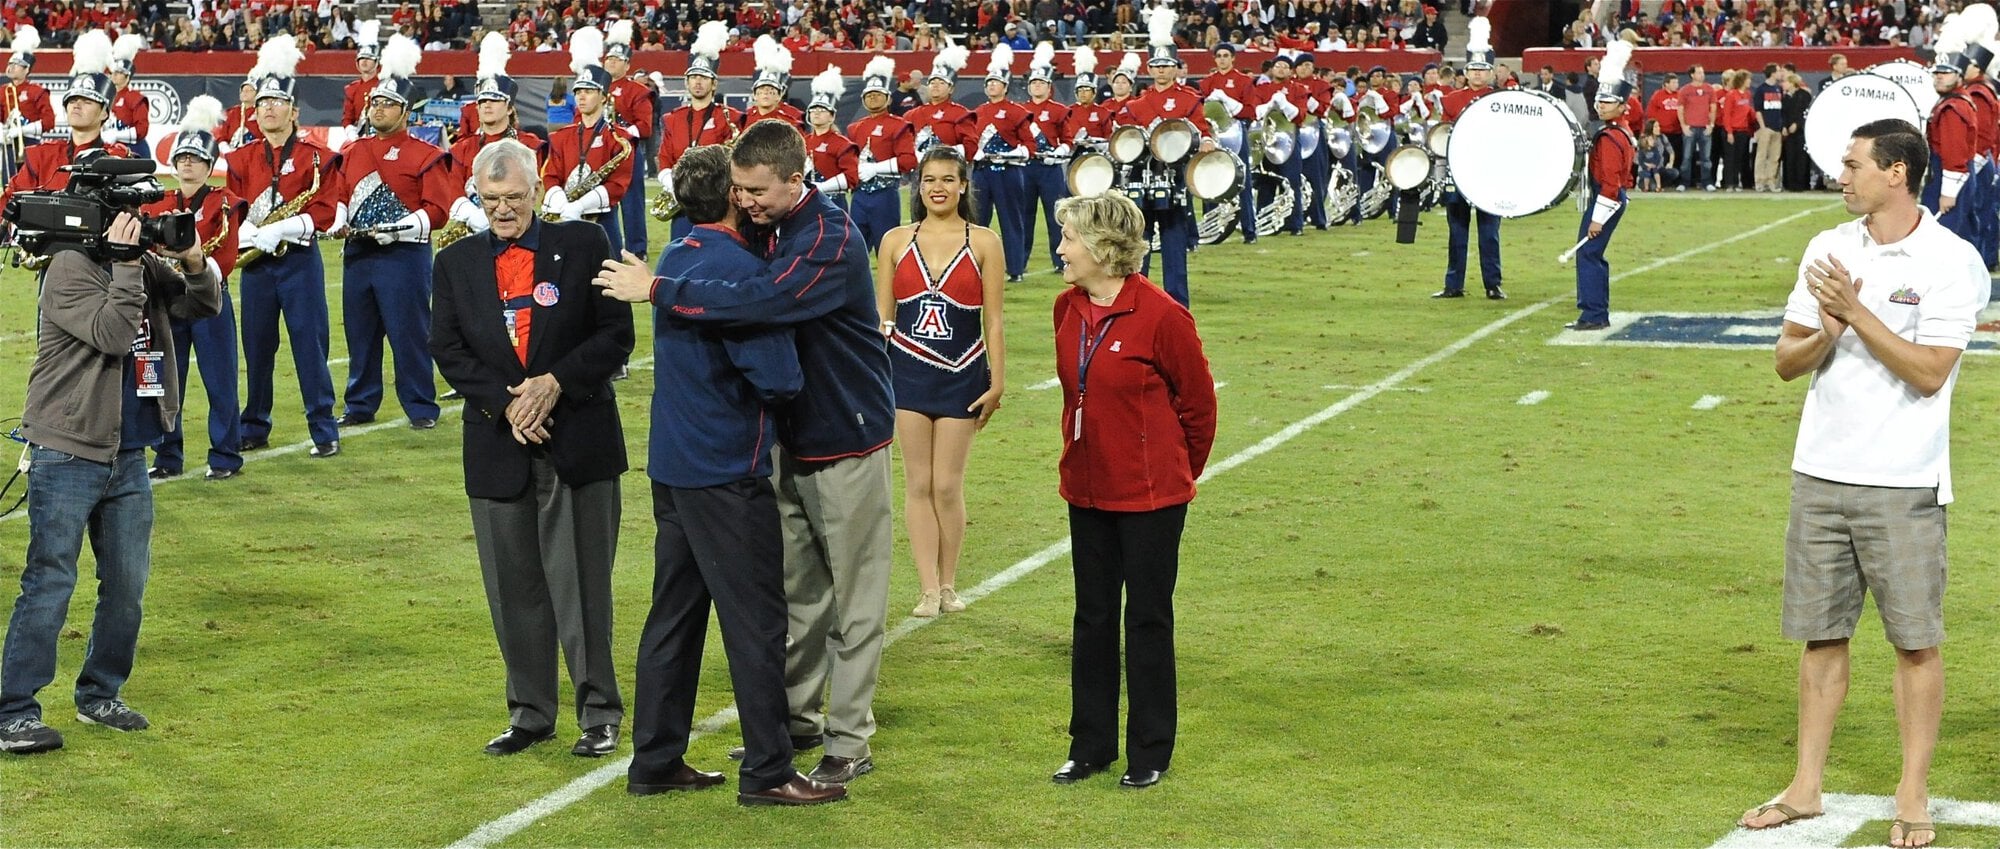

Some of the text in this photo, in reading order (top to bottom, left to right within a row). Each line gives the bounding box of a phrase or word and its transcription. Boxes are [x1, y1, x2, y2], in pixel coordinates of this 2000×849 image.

[1855, 88, 1895, 101] YAMAHA
[1503, 103, 1543, 117] YAMAHA
[912, 300, 953, 340] A
[142, 362, 157, 380] A
